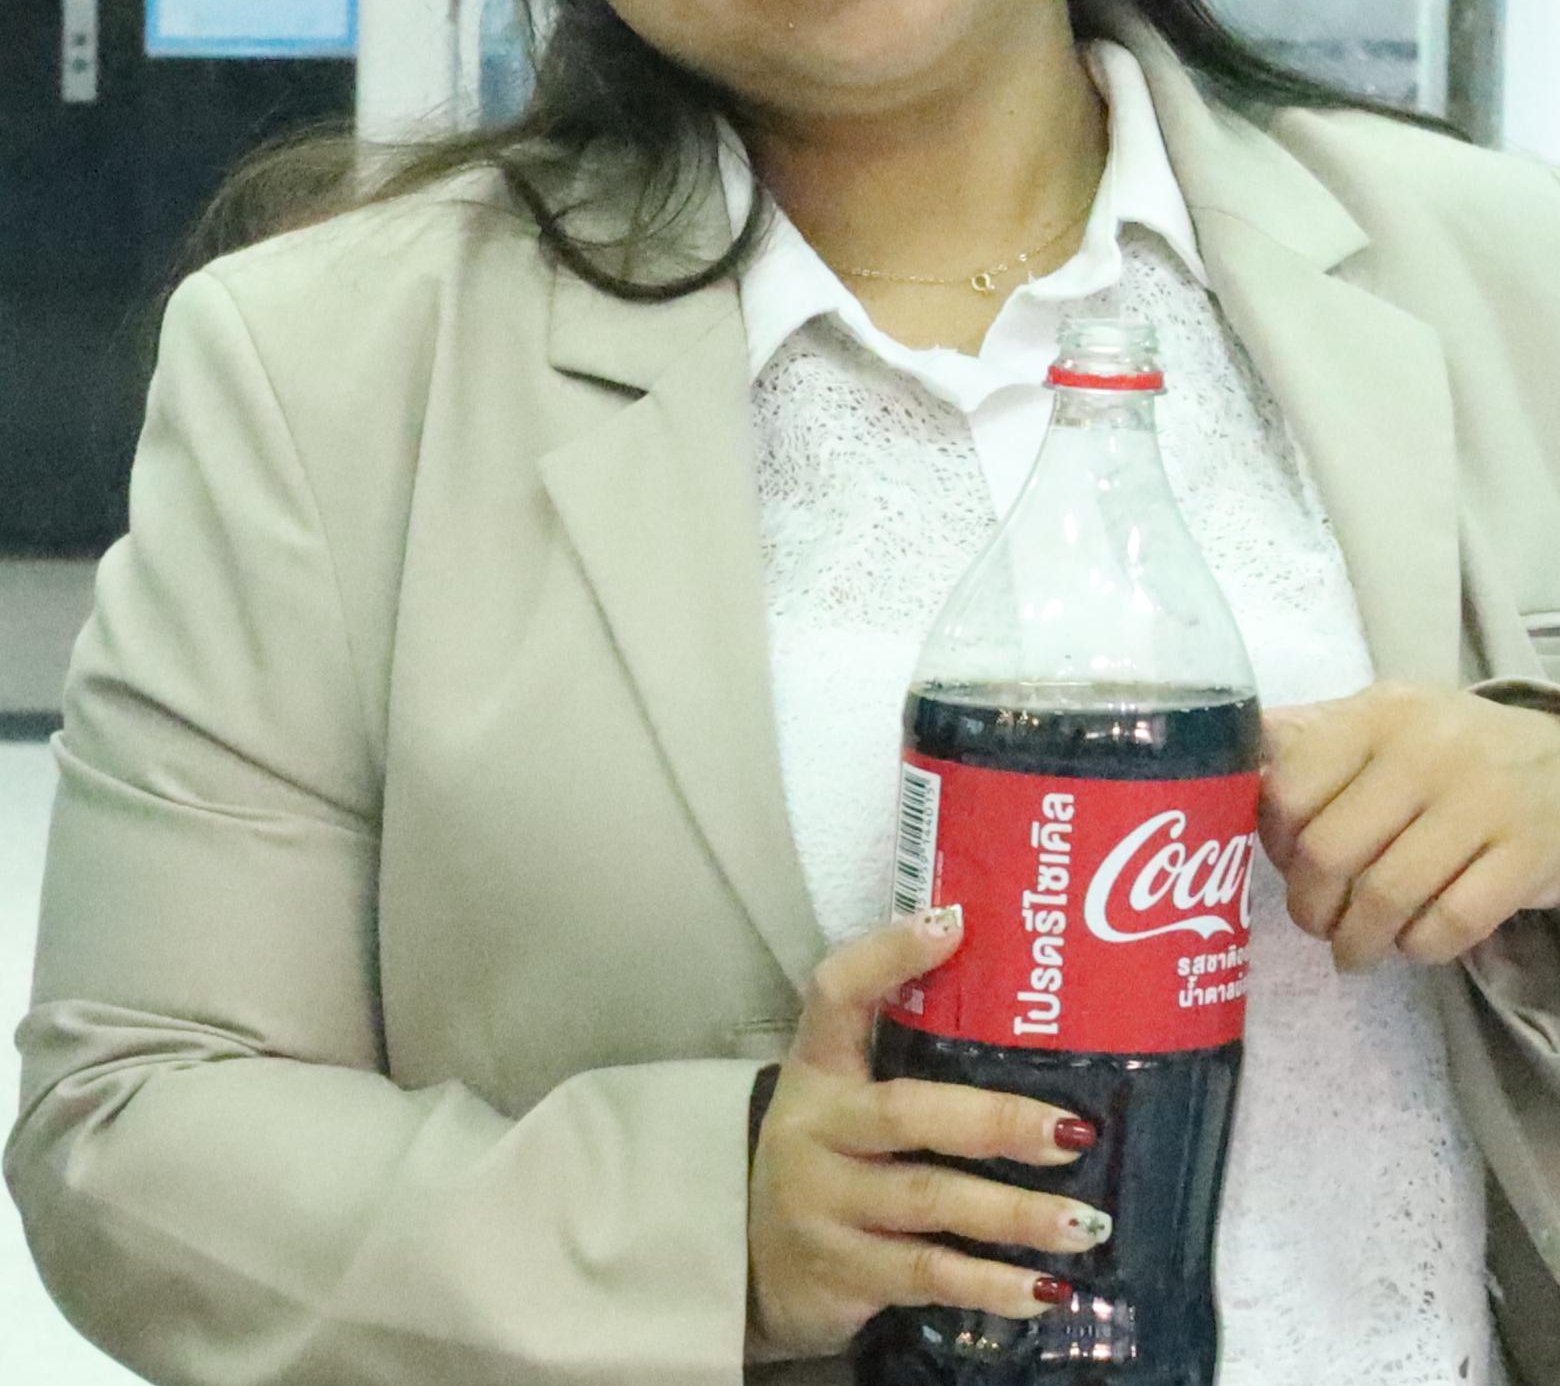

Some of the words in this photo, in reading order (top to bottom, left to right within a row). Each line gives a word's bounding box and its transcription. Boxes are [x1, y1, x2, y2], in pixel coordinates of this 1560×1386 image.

[1013, 792, 1075, 1036] โปรดรีไซเคิล
